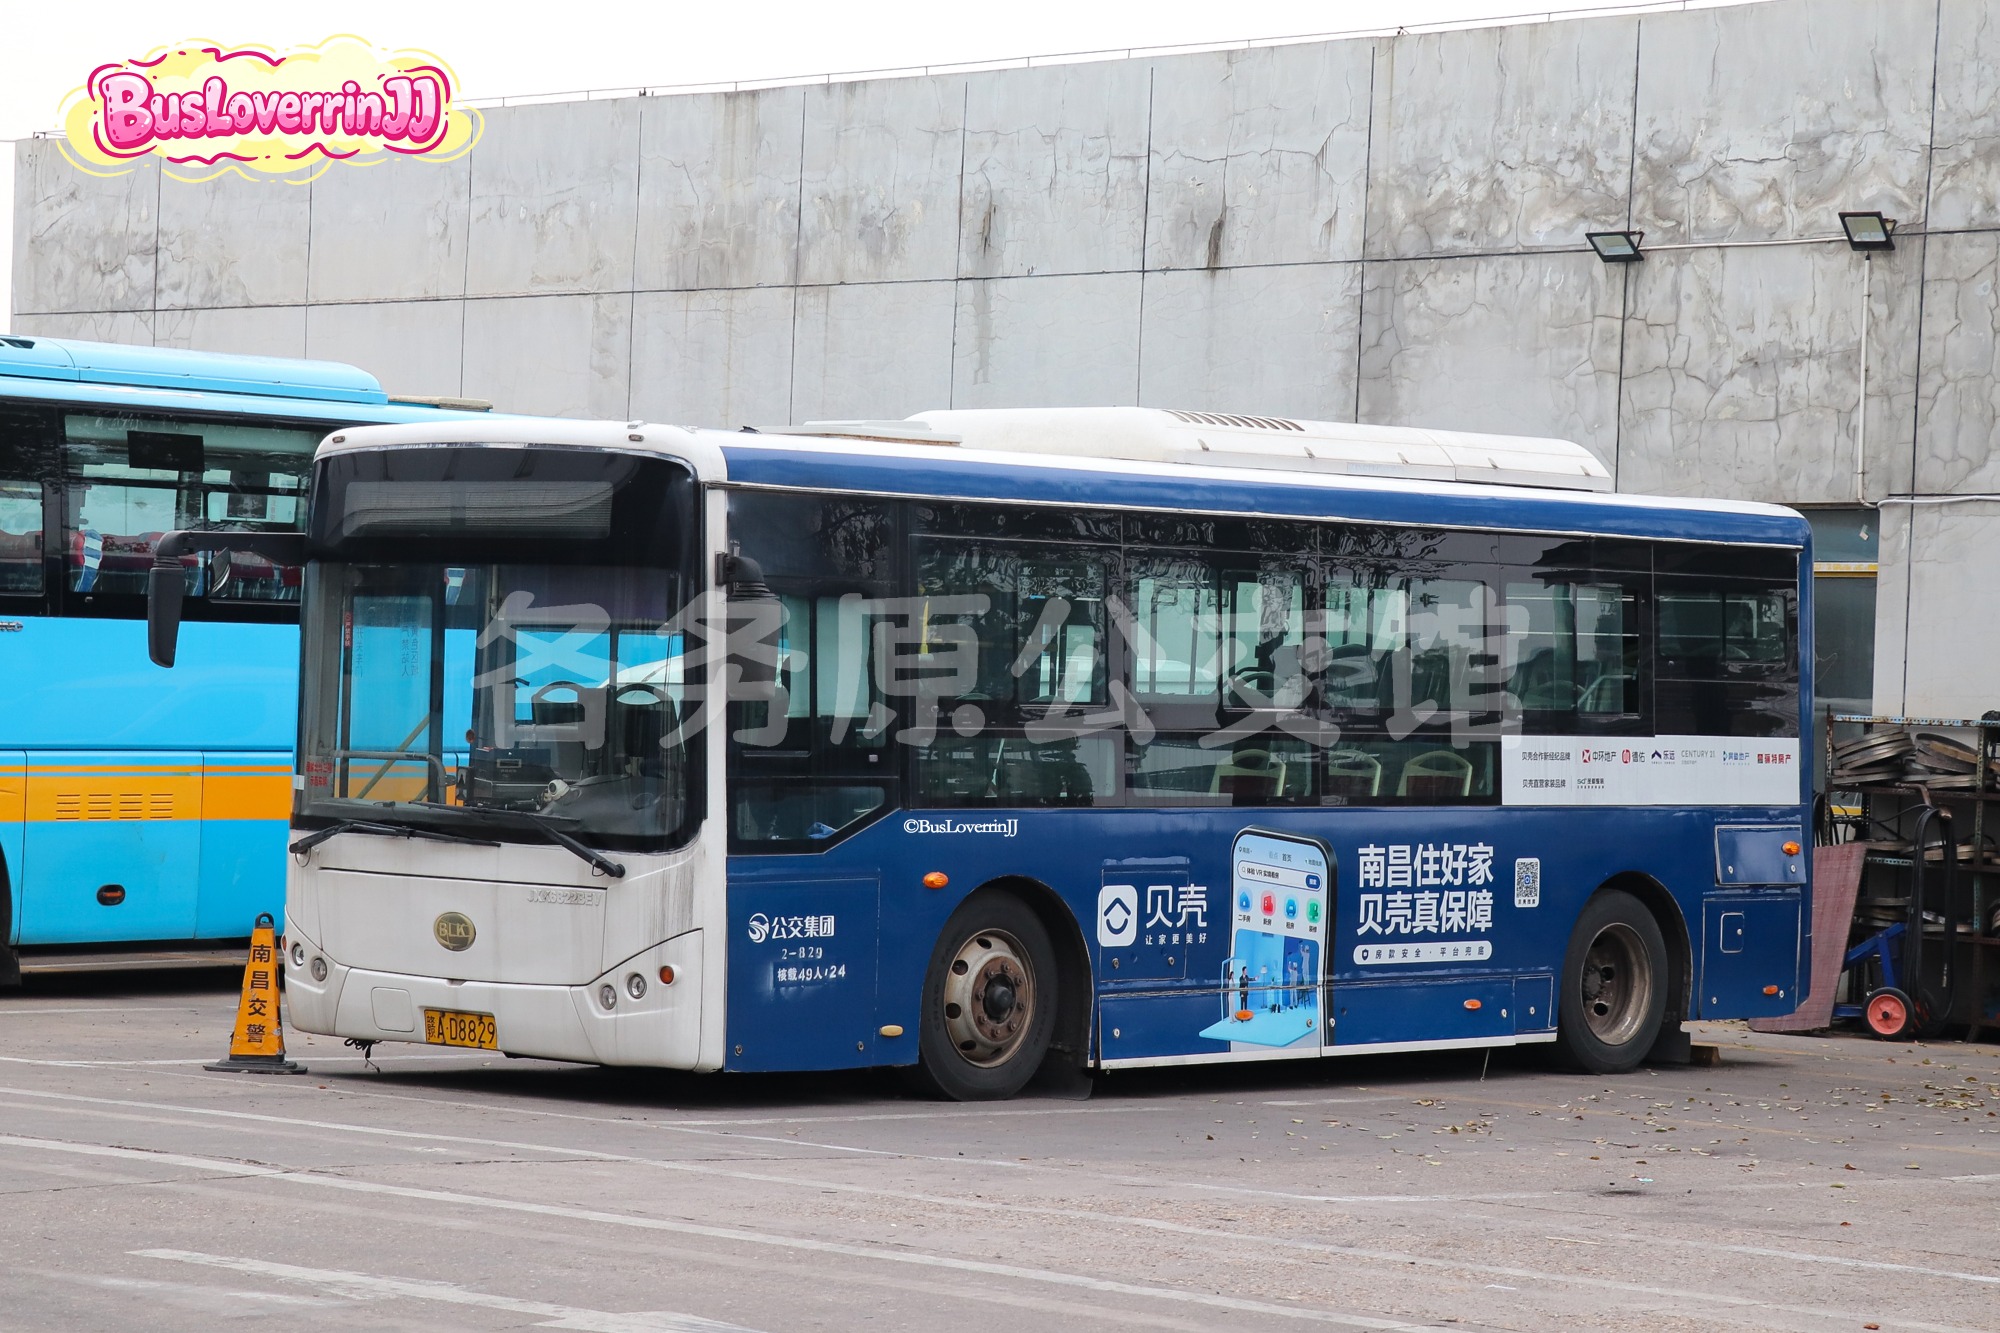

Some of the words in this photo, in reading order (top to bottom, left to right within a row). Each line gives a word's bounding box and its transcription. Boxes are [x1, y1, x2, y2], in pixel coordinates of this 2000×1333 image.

[1592, 751, 1617, 762] 中环地产
[1681, 750, 1708, 759] CENTURY
[1357, 841, 1494, 888] 南昌住好家
[1146, 883, 1207, 929] 贝壳
[1356, 888, 1494, 936] 贝壳真保障
[771, 915, 835, 939] 公交集团
[1145, 933, 1207, 945] 让家更美好
[781, 946, 823, 960] 2-829
[246, 943, 272, 1043] 南昌交警
